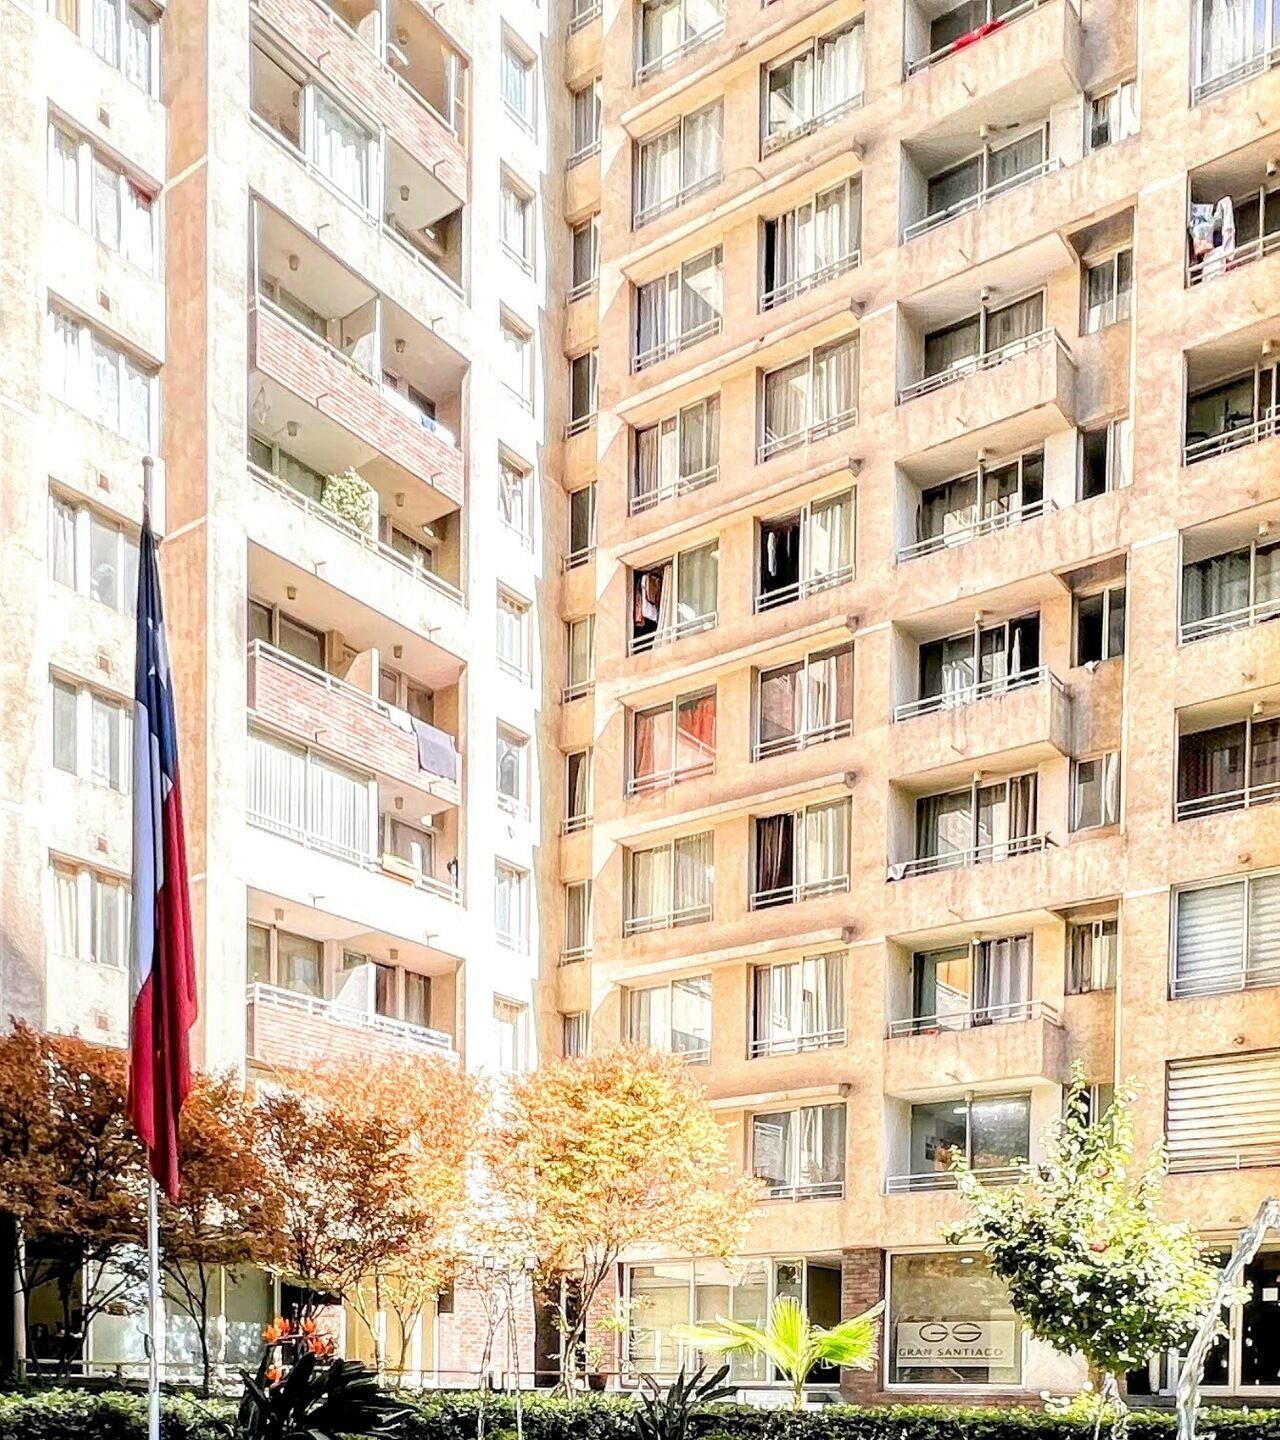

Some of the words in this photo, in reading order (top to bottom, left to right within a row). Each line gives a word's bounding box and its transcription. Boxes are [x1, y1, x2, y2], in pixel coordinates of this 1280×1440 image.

[919, 1322, 982, 1343] GS
[898, 1347, 932, 1357] GRAN
[937, 1347, 1004, 1357] SANTIAGO
